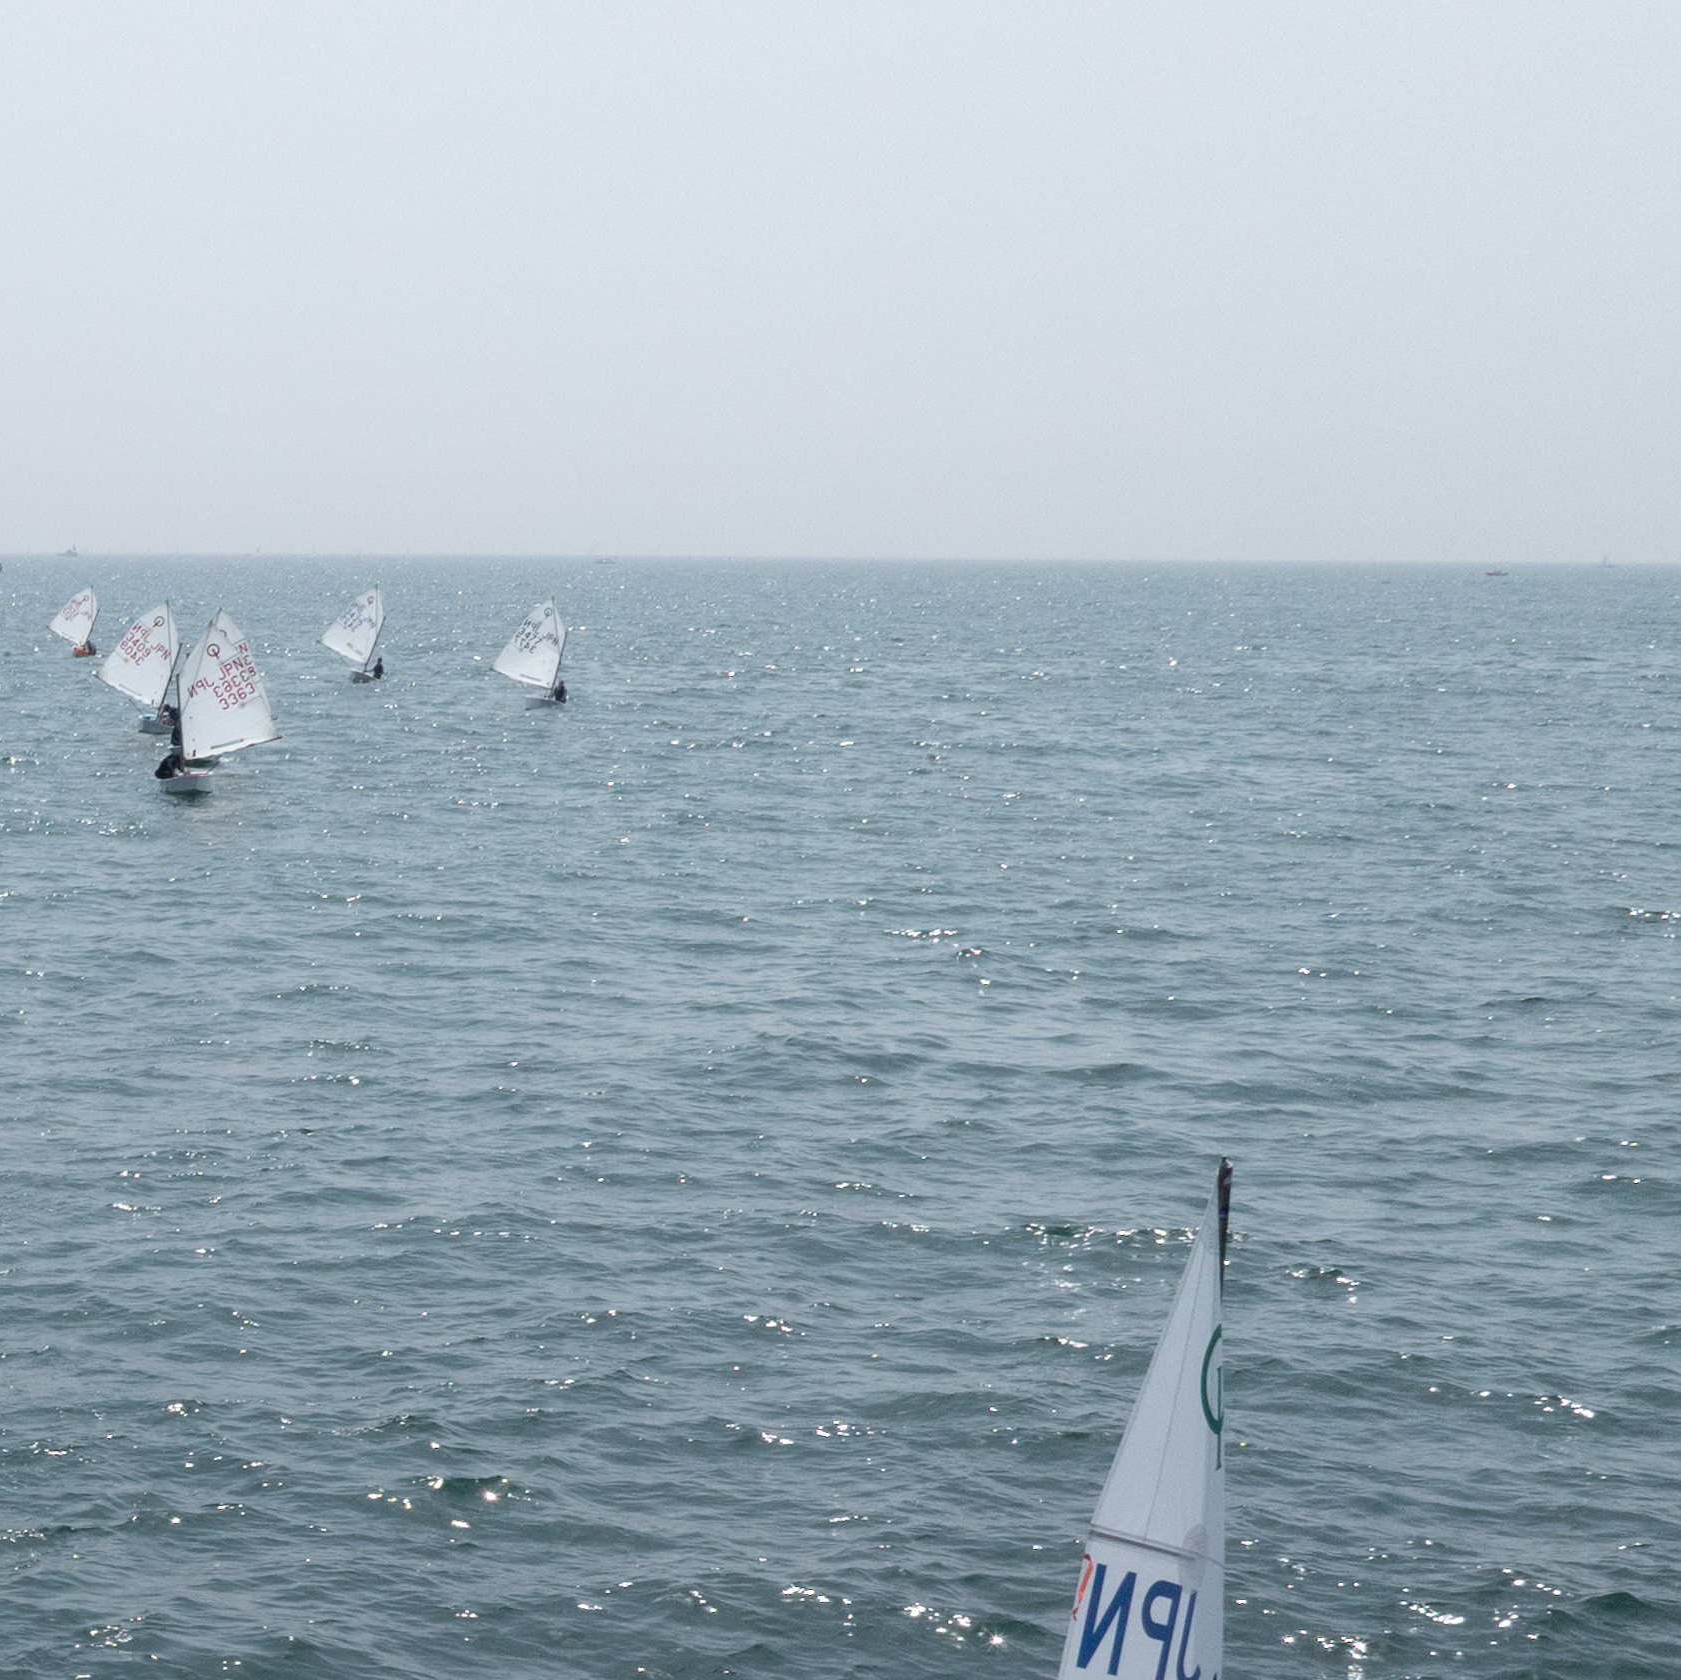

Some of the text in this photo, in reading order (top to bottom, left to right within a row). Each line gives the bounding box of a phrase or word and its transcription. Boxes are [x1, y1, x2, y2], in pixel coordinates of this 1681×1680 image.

[125, 632, 151, 658] 3409
[518, 627, 543, 645] 3477
[542, 632, 559, 646] JPN
[150, 643, 170, 661] JPN
[219, 656, 245, 681] JPN
[219, 682, 256, 711] 3363
